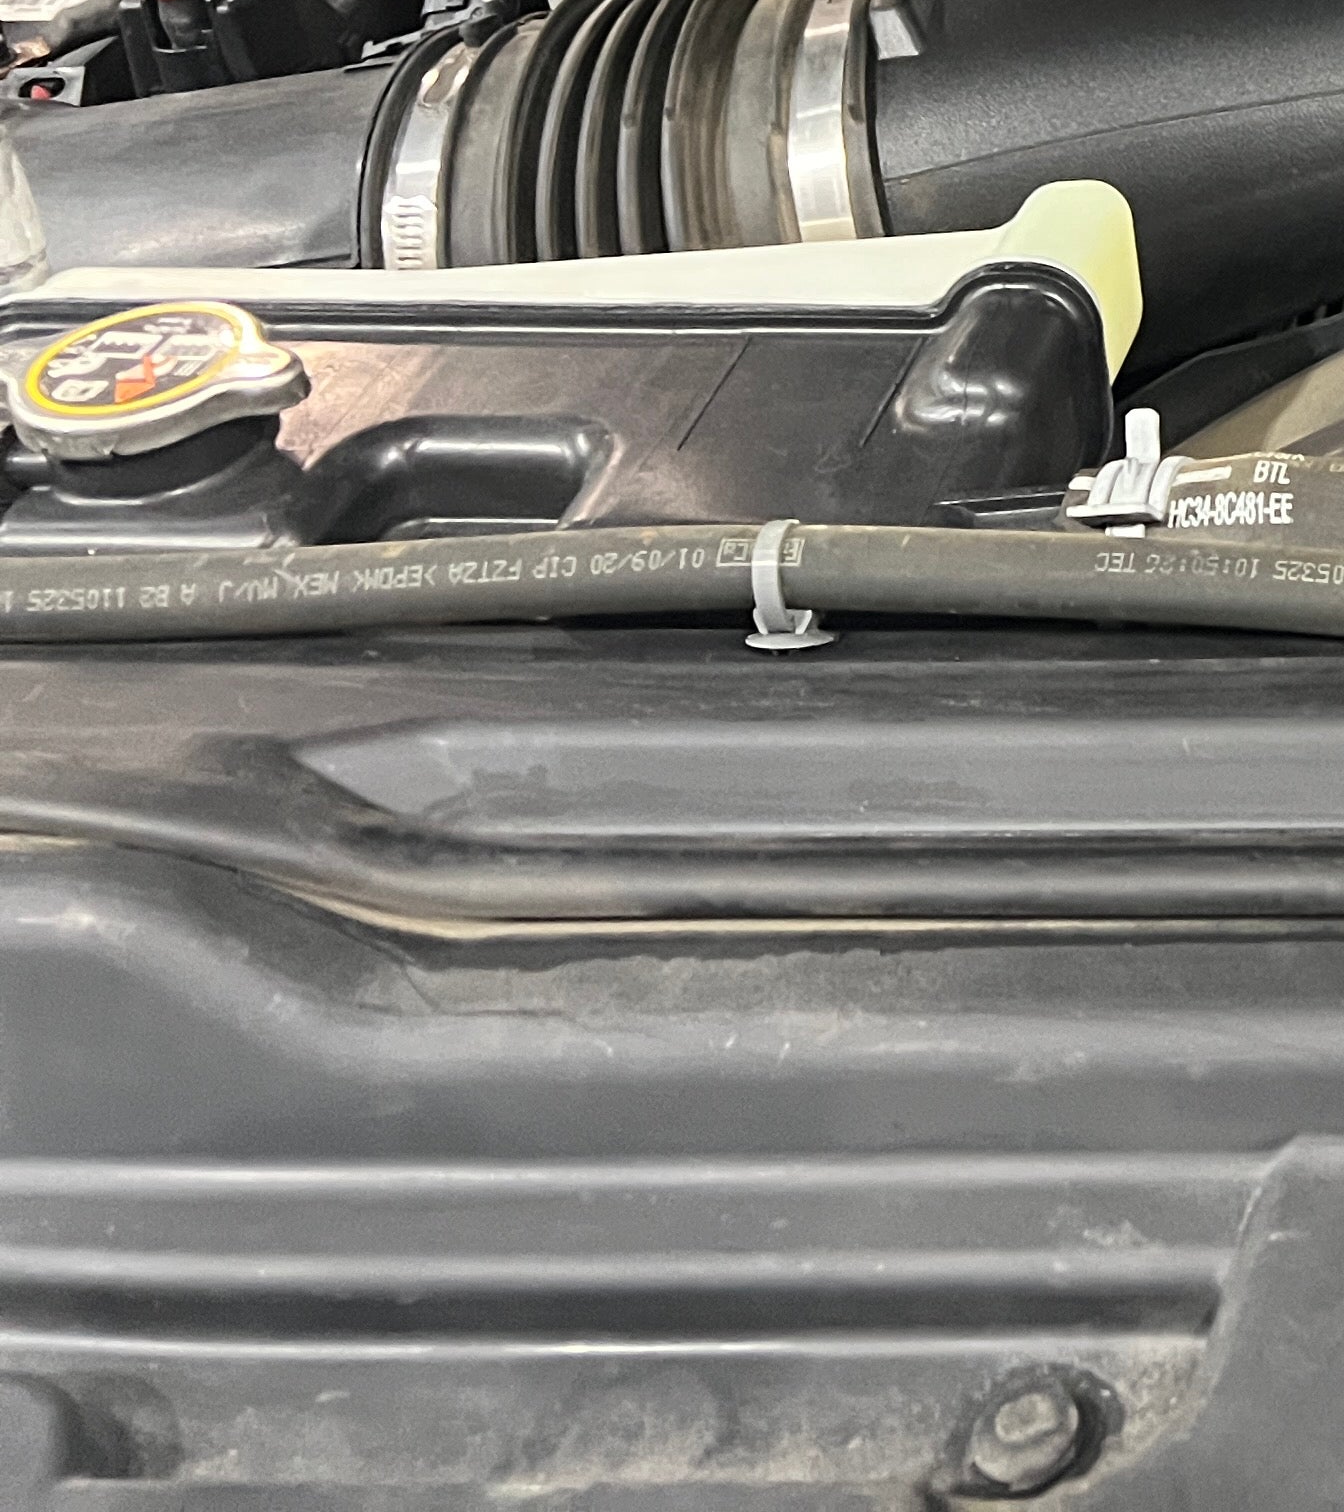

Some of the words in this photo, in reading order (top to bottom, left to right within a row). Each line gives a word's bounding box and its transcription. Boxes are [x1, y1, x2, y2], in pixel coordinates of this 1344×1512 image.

[1252, 460, 1291, 485] BTL
[532, 556, 577, 579] CIP
[590, 548, 705, 575] 01/09/20
[1095, 552, 1136, 574] TEC
[180, 583, 196, 606] A
[294, 571, 339, 599] MEX
